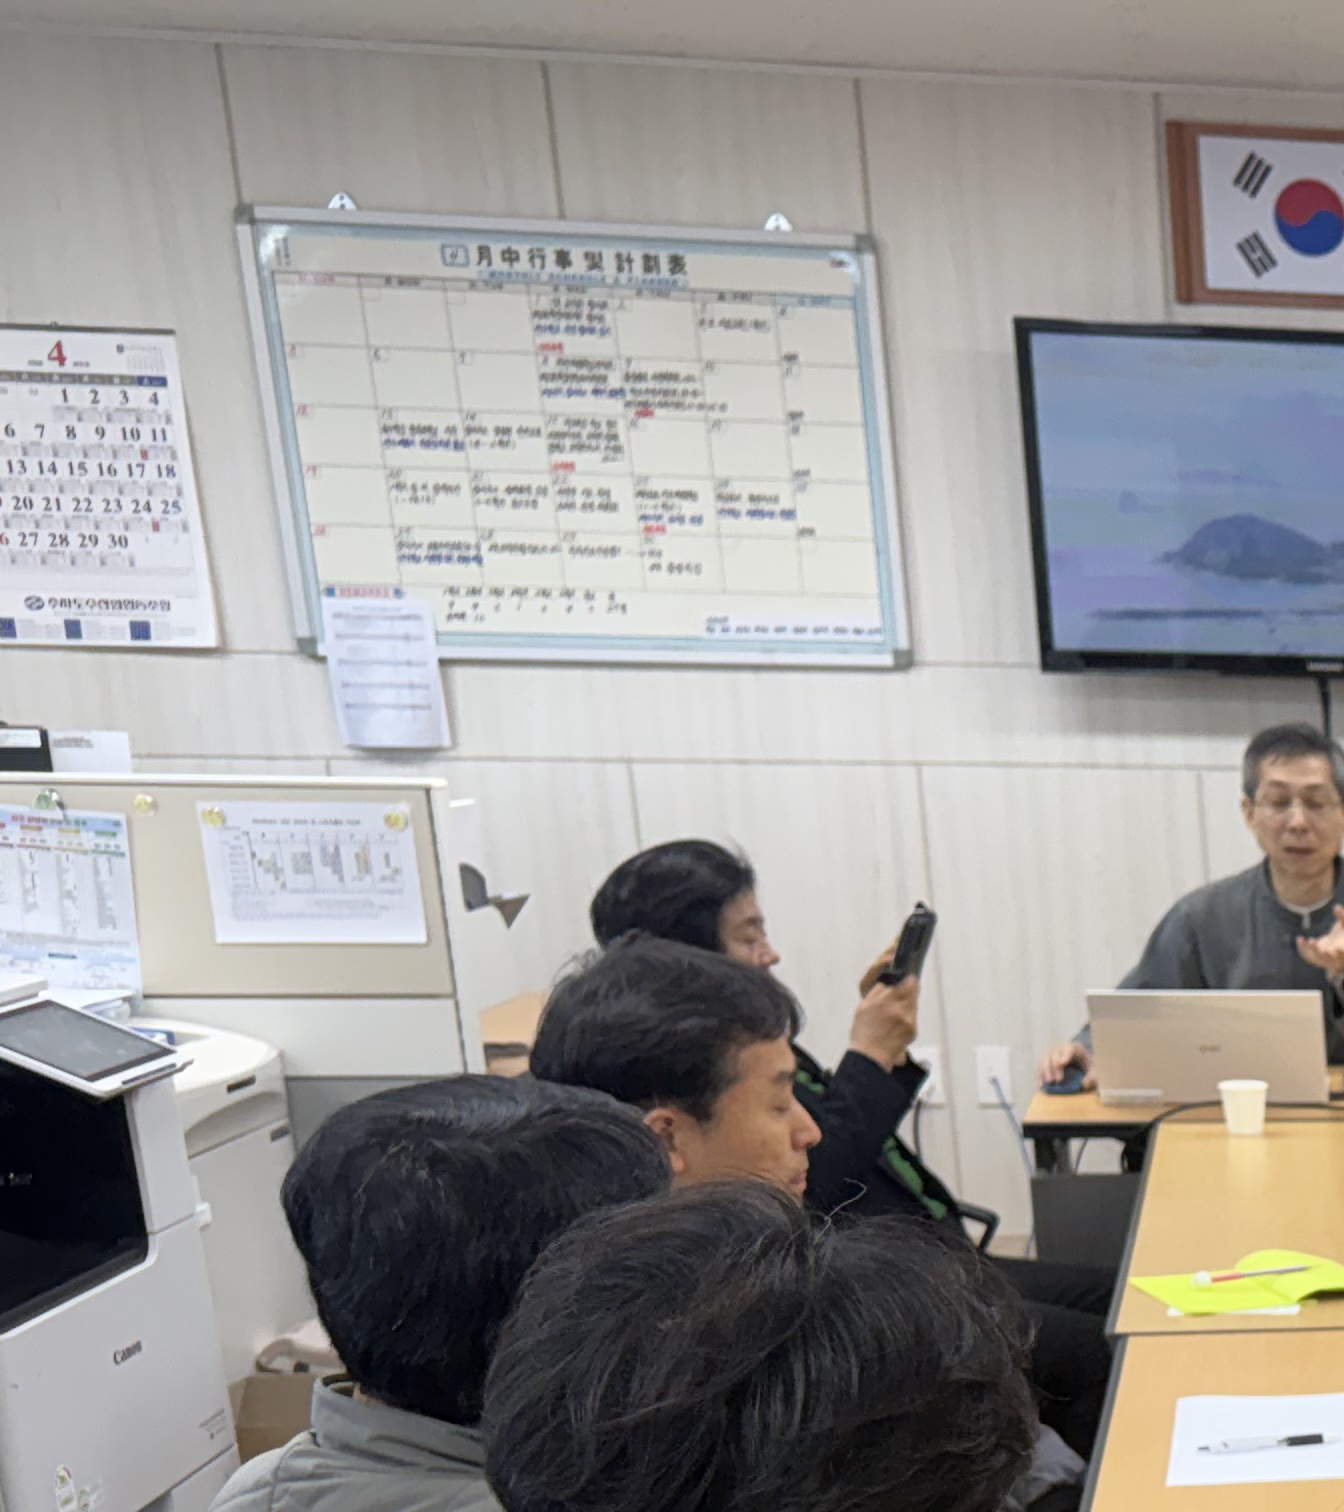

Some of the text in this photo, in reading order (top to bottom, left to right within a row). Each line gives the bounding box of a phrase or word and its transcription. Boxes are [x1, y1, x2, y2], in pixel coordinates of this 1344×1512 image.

[47, 340, 67, 367] 4
[61, 388, 68, 403] 1
[88, 389, 100, 404] 2
[120, 389, 129, 404] 3
[149, 391, 160, 406] 4
[4, 423, 167, 442] 6 7 8 9 10 11
[7, 460, 177, 478] 13 14 15 16 17 18
[12, 496, 182, 514] 20 21 22 23 24 25
[18, 531, 39, 547] 27
[48, 532, 70, 548] 28
[78, 533, 99, 548] 29
[108, 534, 129, 549] 30
[113, 1340, 142, 1366] Canon
